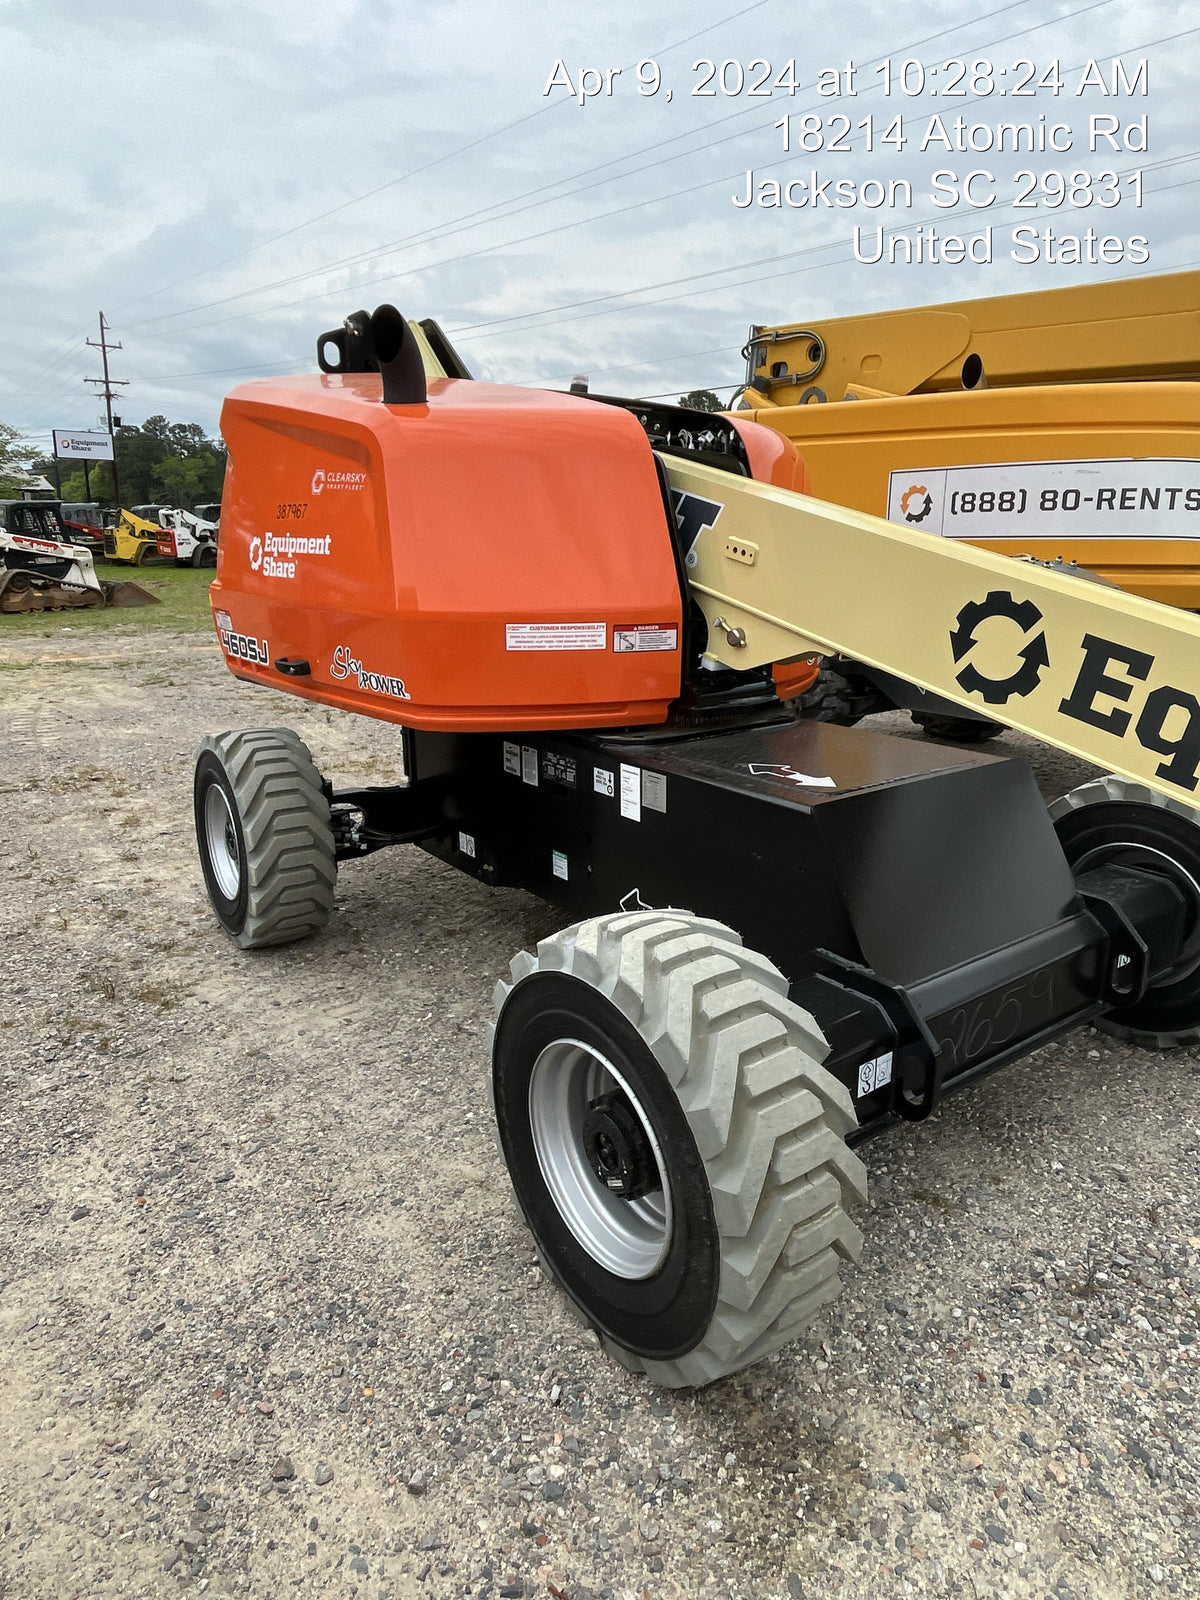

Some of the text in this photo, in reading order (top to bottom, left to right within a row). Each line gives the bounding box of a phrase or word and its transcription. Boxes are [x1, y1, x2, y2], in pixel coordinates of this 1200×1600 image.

[70, 439, 108, 447] Equipment
[327, 472, 366, 482] CLEARSKY
[276, 503, 308, 520] 387967
[951, 488, 1027, 514] (888)
[264, 531, 332, 556] Equipment
[263, 556, 296, 578] Share
[222, 631, 270, 665] 460SJ
[1058, 633, 1200, 792] Eq
